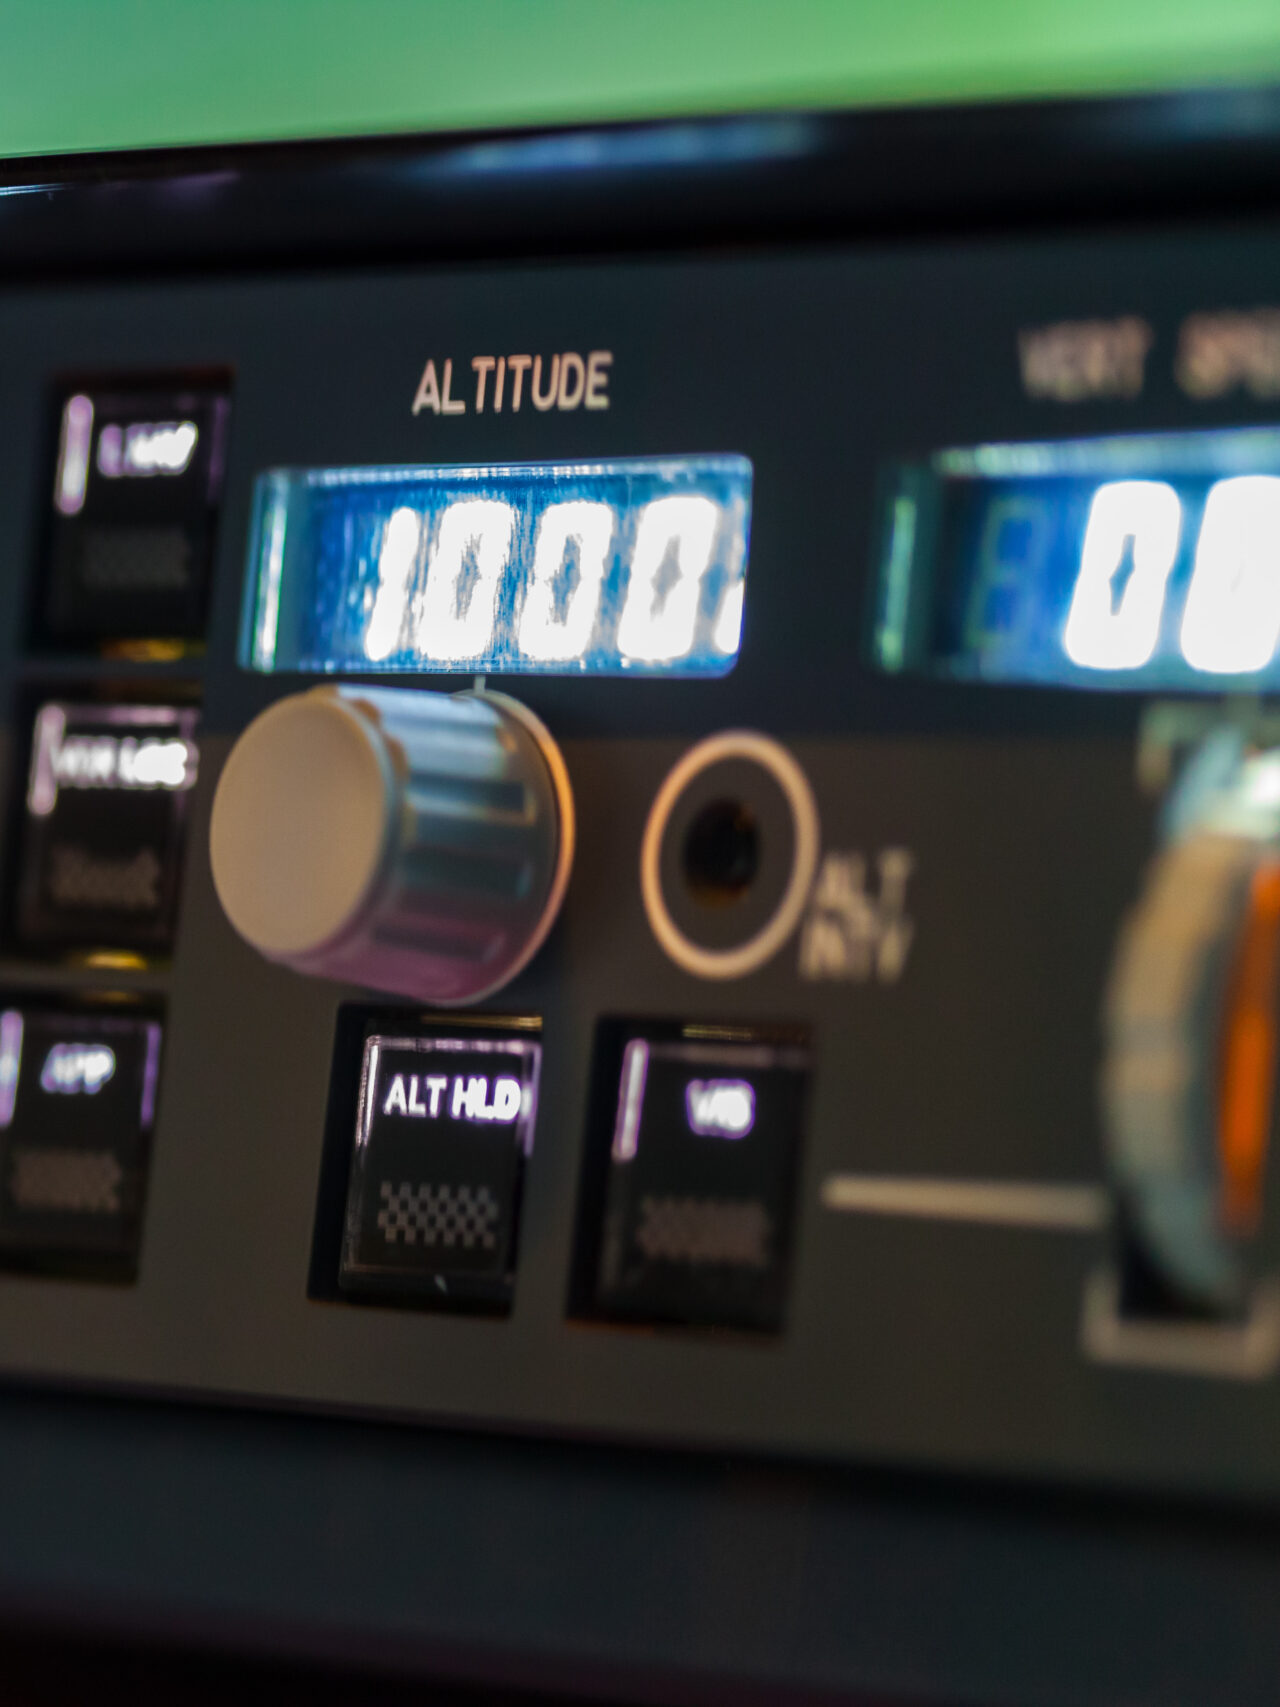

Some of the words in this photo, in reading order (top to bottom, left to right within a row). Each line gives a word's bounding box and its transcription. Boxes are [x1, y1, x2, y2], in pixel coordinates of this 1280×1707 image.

[412, 350, 613, 415] ALTITUDE
[384, 1075, 447, 1118] ALT
[450, 1075, 521, 1123] HLD
